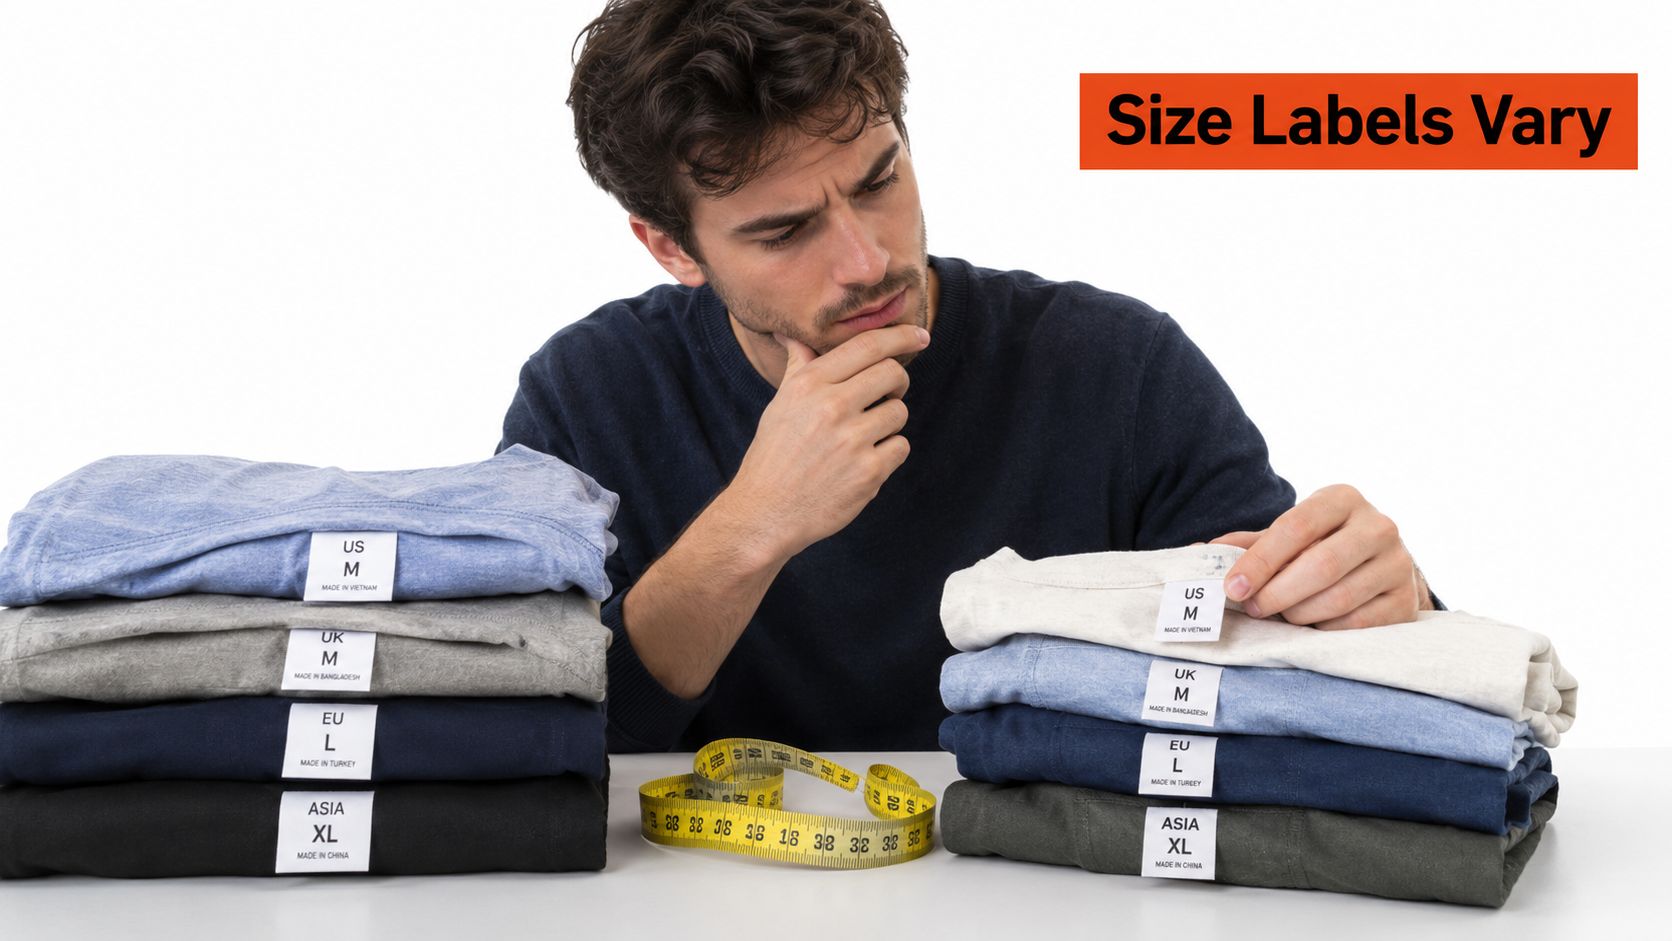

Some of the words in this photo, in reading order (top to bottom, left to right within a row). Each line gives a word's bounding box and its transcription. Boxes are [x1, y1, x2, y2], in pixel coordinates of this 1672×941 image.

[343, 540, 364, 554] US
[343, 561, 360, 577] M
[1184, 587, 1205, 600] US
[1183, 606, 1199, 621] M
[321, 631, 344, 643] UK
[321, 650, 338, 666] M
[293, 672, 312, 680] MADE
[320, 673, 361, 681] BANGLADESH
[1174, 668, 1197, 681] UK
[1173, 686, 1190, 702] M
[1148, 704, 1165, 712] MADE
[322, 712, 344, 725] EU
[324, 733, 336, 752] L
[1169, 740, 1190, 751] EU
[299, 759, 320, 767] MADE
[329, 760, 356, 768] TURKEY
[1172, 757, 1183, 773] L
[307, 801, 345, 816] ASIA
[1161, 816, 1200, 831] ASIA
[311, 824, 338, 844] XL
[814, 833, 835, 851] 38
[849, 837, 870, 853] 38
[882, 834, 899, 851] 38
[1167, 837, 1192, 855] XL
[296, 851, 317, 859] MADE
[1155, 860, 1174, 868] MADE
